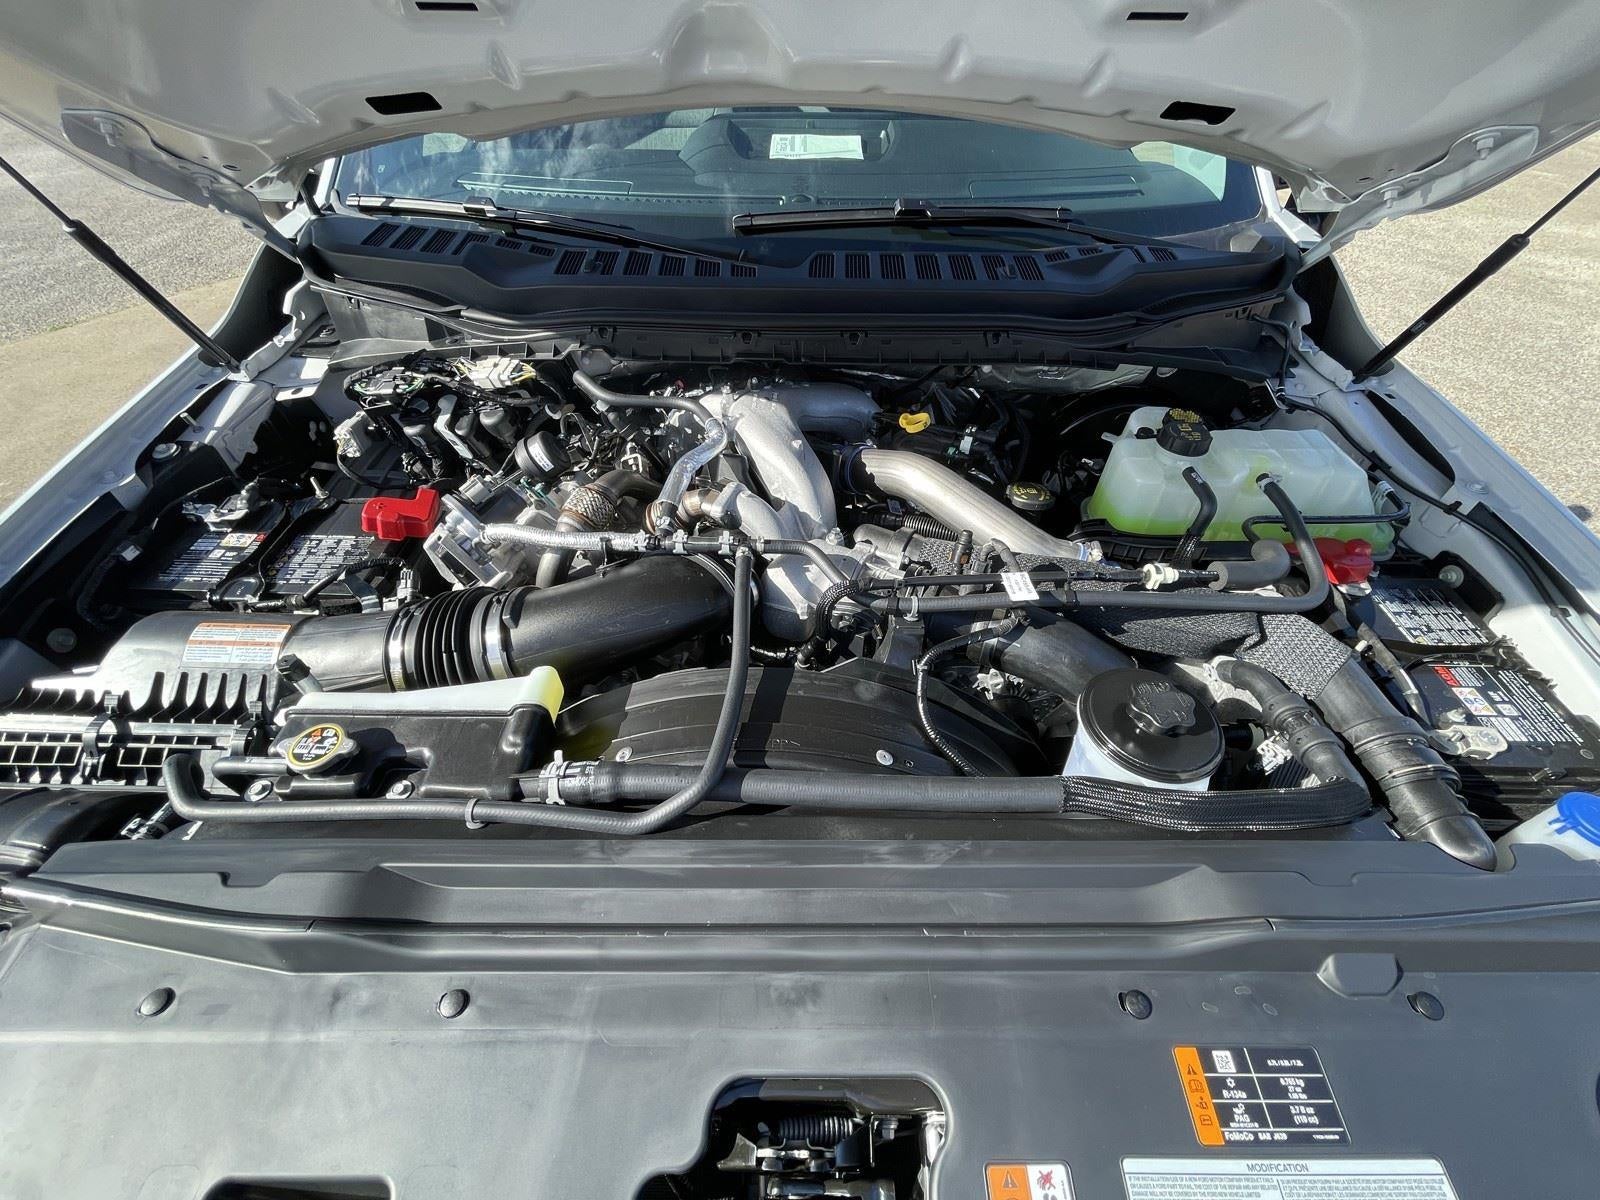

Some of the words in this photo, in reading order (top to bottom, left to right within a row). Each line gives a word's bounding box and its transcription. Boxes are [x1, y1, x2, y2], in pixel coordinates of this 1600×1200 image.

[1222, 1089, 1248, 1099] R-134a
[1306, 1106, 1315, 1114] oz
[1234, 1113, 1250, 1122] PAG
[1224, 1131, 1255, 1141] FoMoCo
[1246, 1163, 1310, 1173] MODIFICATION
